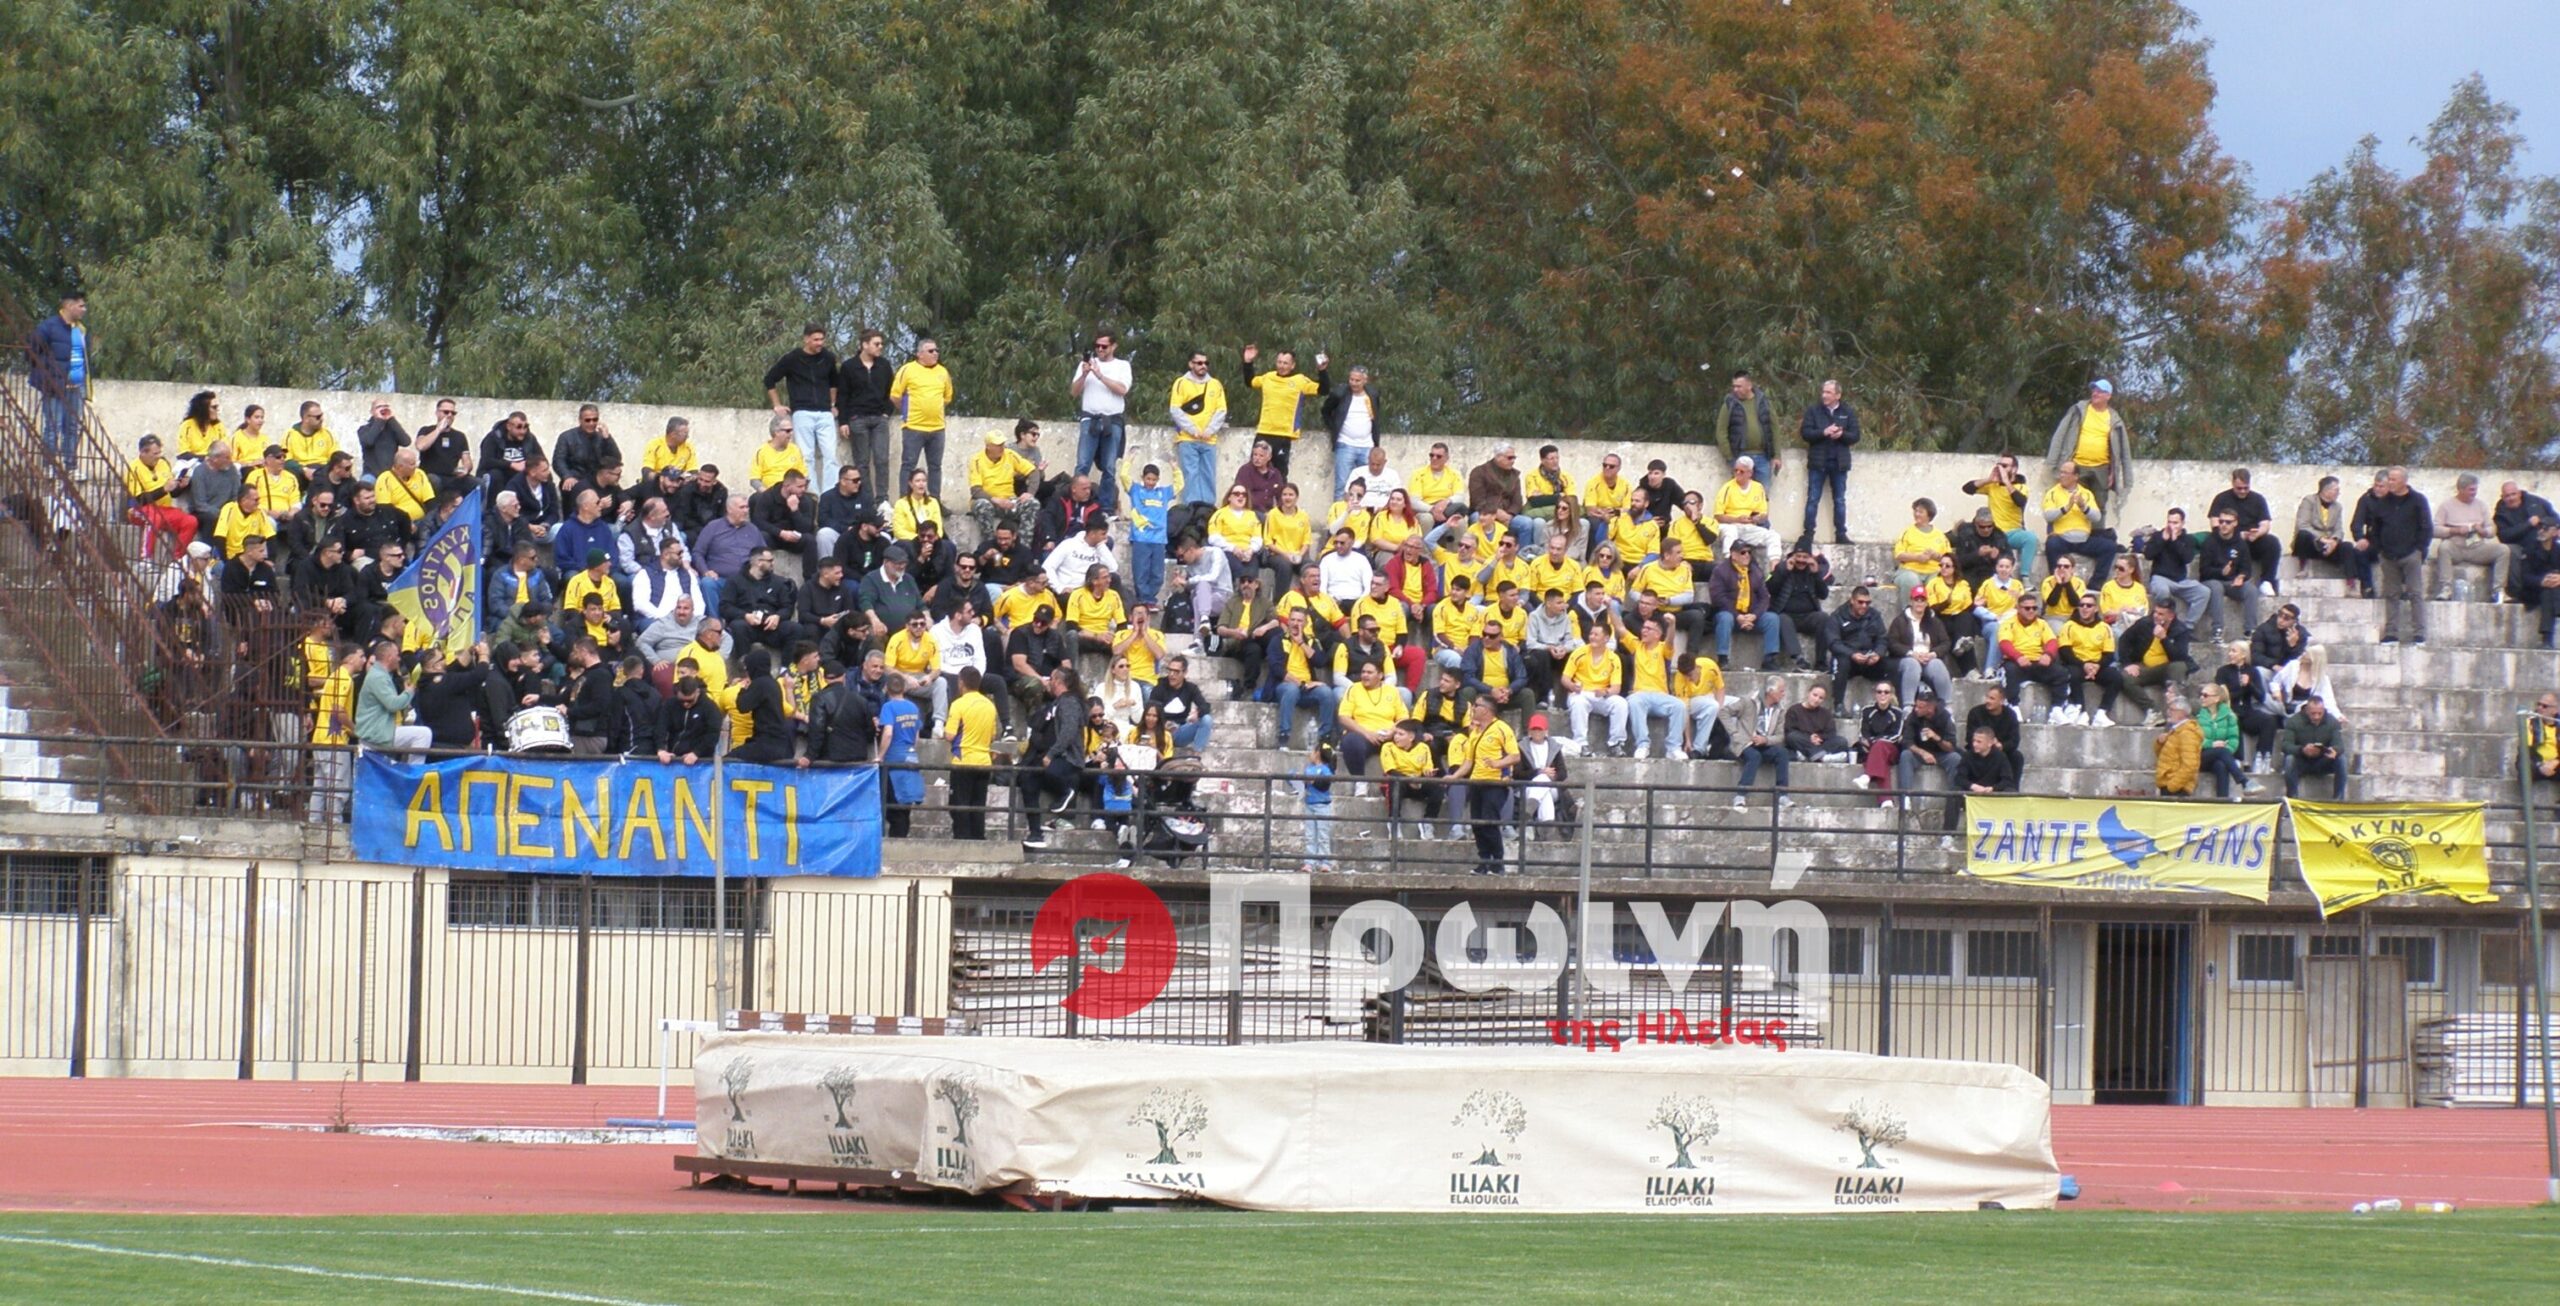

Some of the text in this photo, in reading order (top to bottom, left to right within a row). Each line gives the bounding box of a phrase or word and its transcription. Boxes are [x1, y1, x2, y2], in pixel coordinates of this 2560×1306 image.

[405, 770, 798, 865] ΑΠΕΝΑΝΤΙ
[1973, 821, 2271, 871] ZANTE FANS
[828, 1134, 869, 1155] ILIAKI
[1451, 1173, 1520, 1193] ILIAKI
[1646, 1177, 1715, 1195] ILIAKI
[1835, 1177, 1904, 1194] ILIAKI
[1450, 1194, 1520, 1206] ELAIOURGIA
